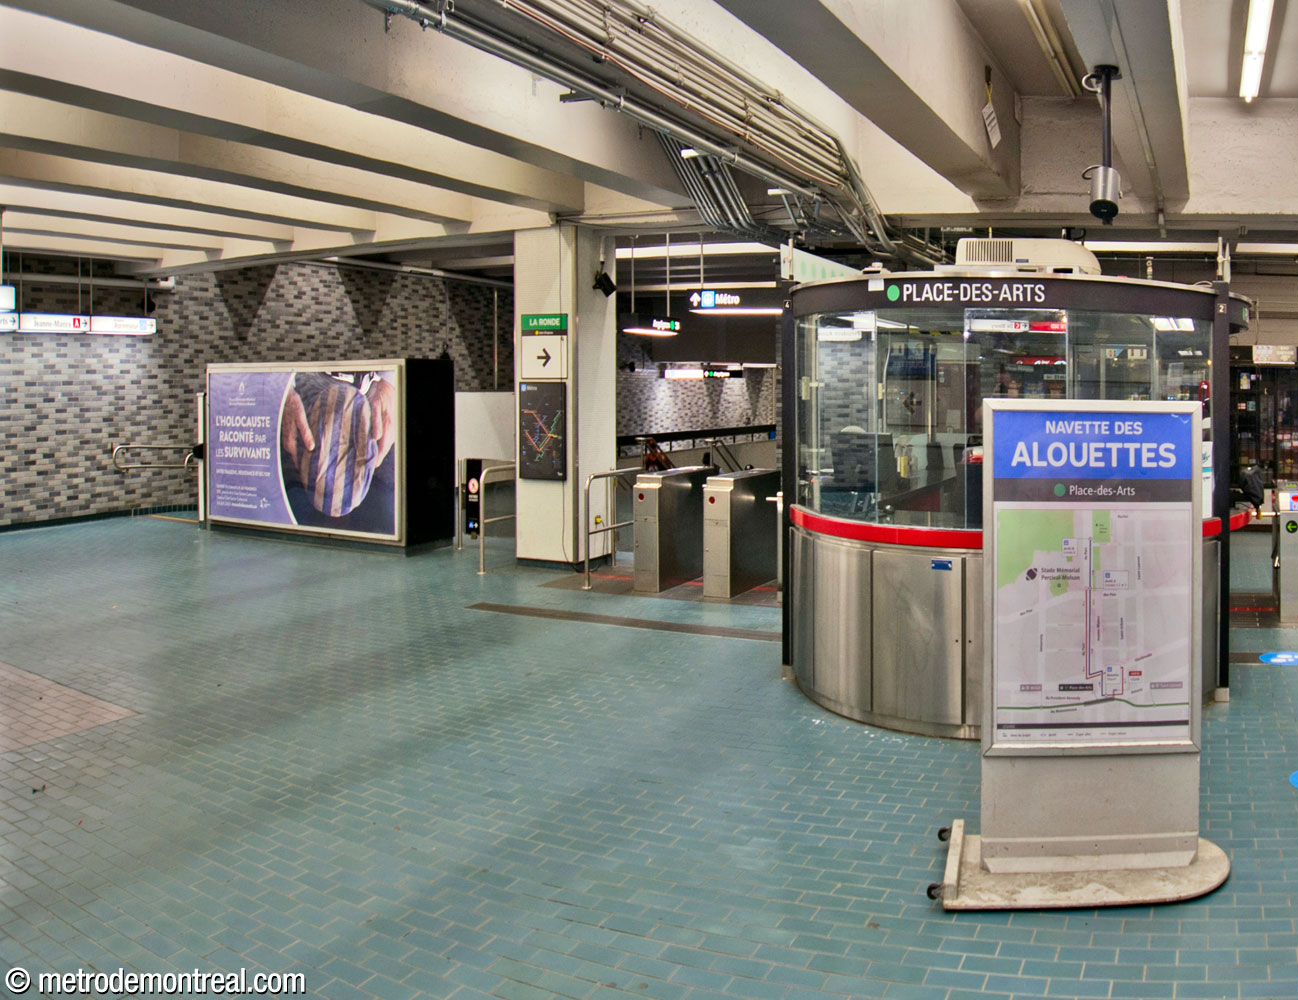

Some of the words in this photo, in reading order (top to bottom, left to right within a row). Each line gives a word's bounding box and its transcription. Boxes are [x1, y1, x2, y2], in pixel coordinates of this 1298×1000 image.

[715, 293, 741, 305] Métro
[903, 283, 1046, 302] PLACE-DES-ARTS
[529, 318, 538, 326] LA
[539, 317, 560, 326] RONDE
[215, 415, 271, 428] L'HOLOCAUSTE
[1045, 420, 1110, 435] NAVETTE
[1114, 421, 1143, 435] DES
[219, 428, 254, 443] RACONTÉ
[255, 434, 267, 443] PAR
[215, 448, 224, 457] LES
[224, 446, 271, 459] SURVIVANTS
[1011, 441, 1177, 468] ALOUETTES
[1069, 485, 1136, 496] Place-des-Arts
